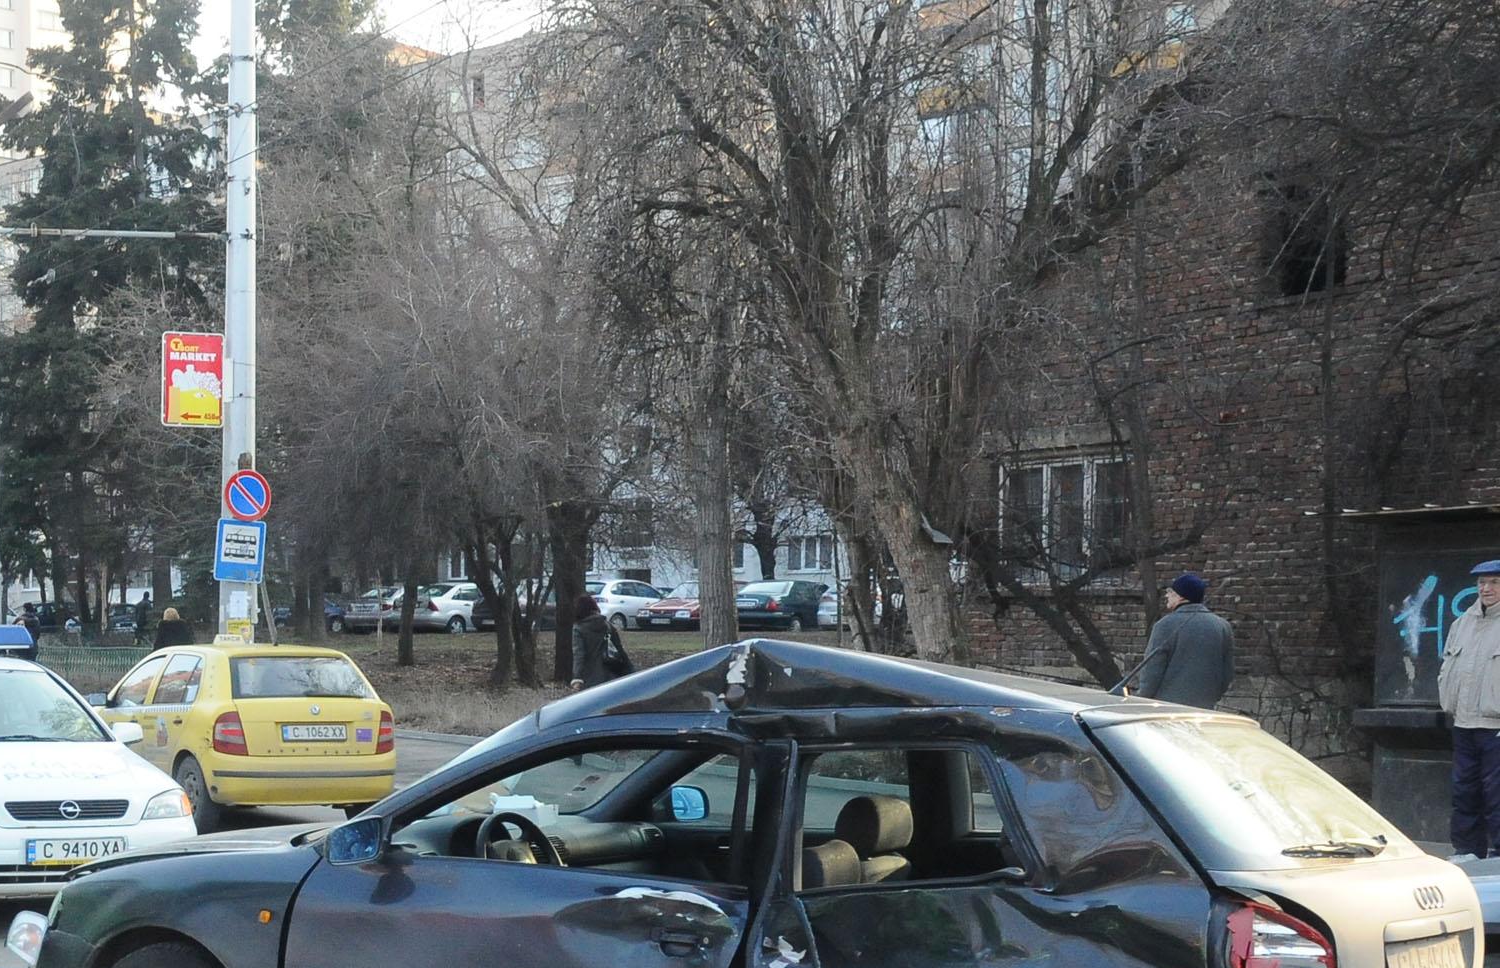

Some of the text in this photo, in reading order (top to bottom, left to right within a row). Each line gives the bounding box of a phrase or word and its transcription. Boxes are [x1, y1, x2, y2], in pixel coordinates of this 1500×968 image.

[169, 351, 217, 362] MARKET
[306, 728, 331, 739] 1062
[331, 728, 345, 738] XX
[43, 843, 53, 858] C
[61, 842, 97, 858] 9410
[101, 840, 120, 856] XA
